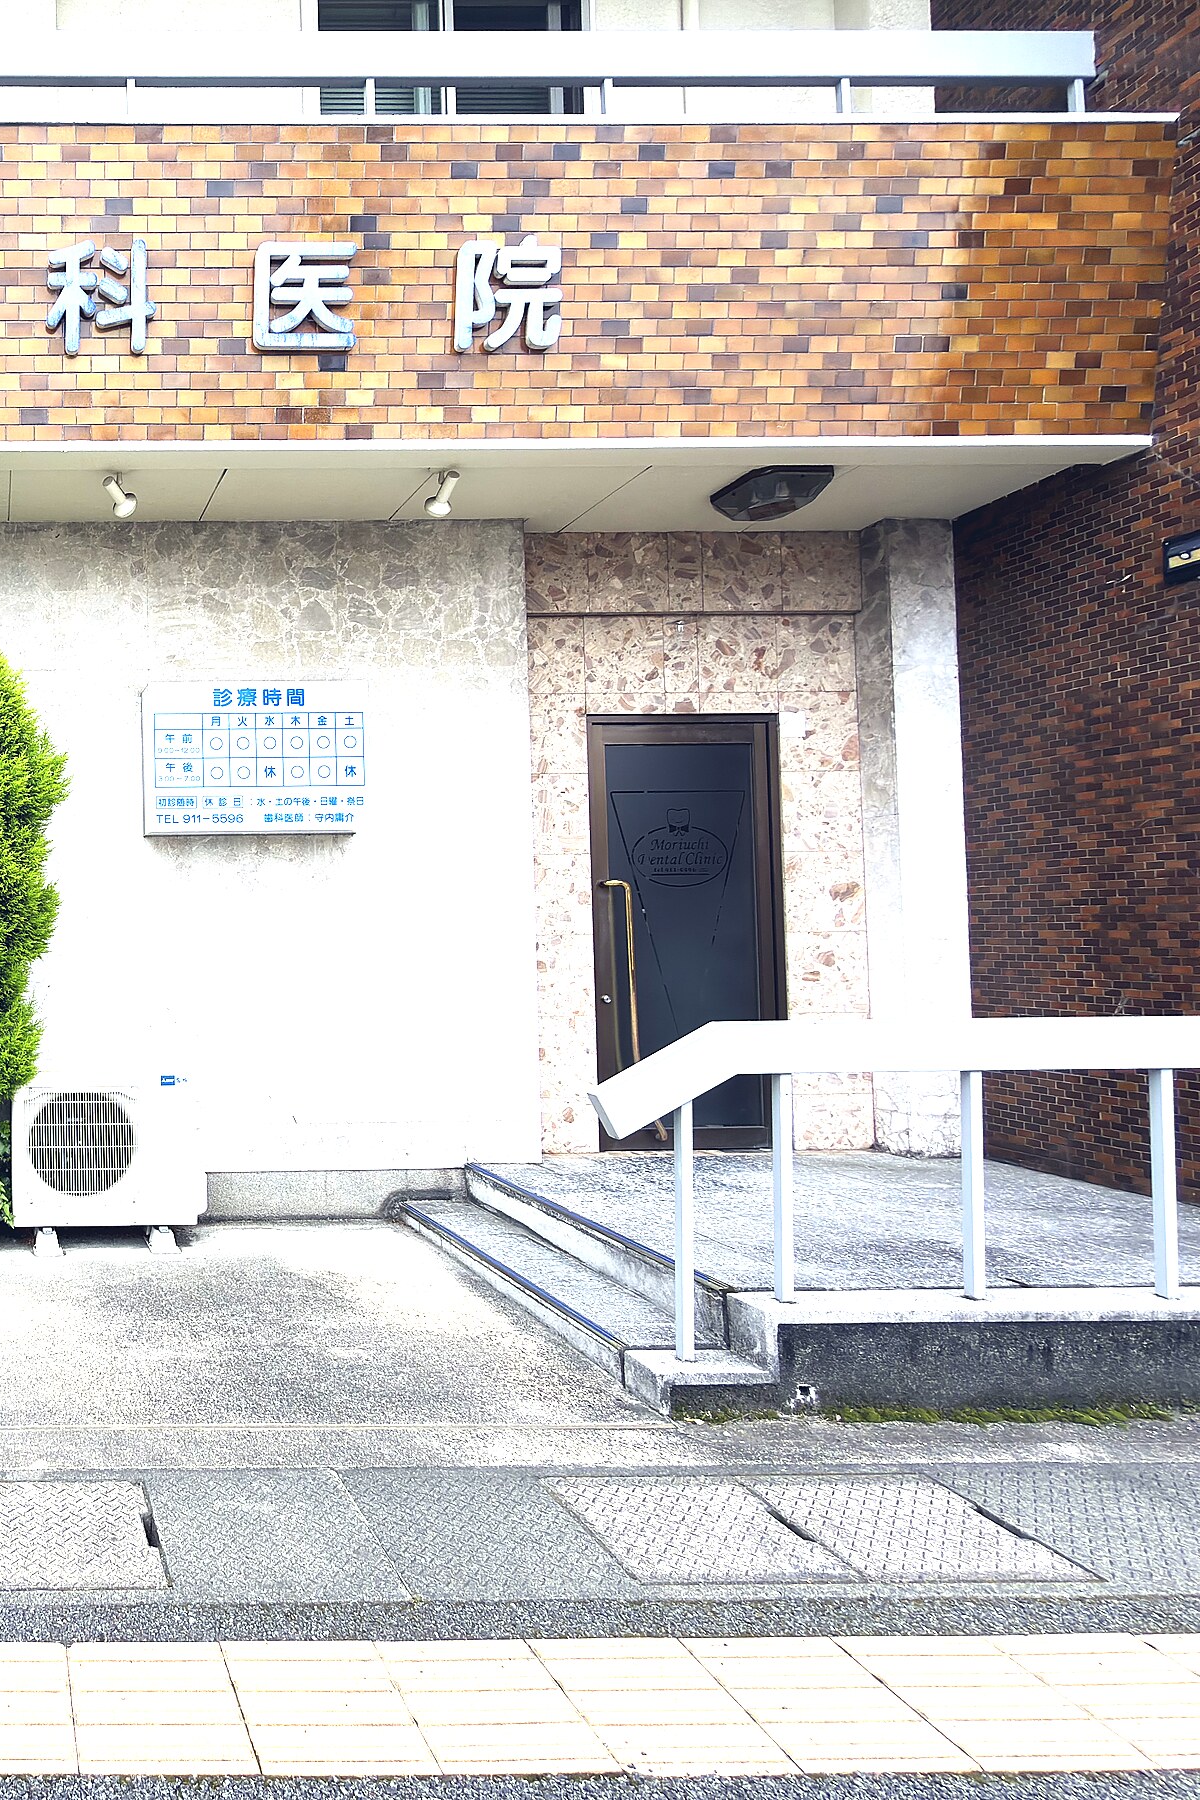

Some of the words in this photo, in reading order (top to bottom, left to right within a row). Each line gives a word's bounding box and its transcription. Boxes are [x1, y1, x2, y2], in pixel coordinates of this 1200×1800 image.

[212, 687, 305, 707] 診療時間
[211, 715, 221, 727] 月
[238, 715, 248, 727] 火
[264, 715, 274, 727] 水
[291, 715, 301, 727] 木
[317, 715, 327, 727] 金
[344, 715, 354, 727] 土
[165, 733, 193, 744] 午前
[165, 762, 194, 773] 午後
[264, 765, 276, 778] 休
[345, 764, 357, 778] 休
[156, 814, 180, 824] TEL
[182, 813, 244, 824] 911-5596
[650, 838, 709, 851] Moriuchi
[685, 851, 723, 866] Clinic
